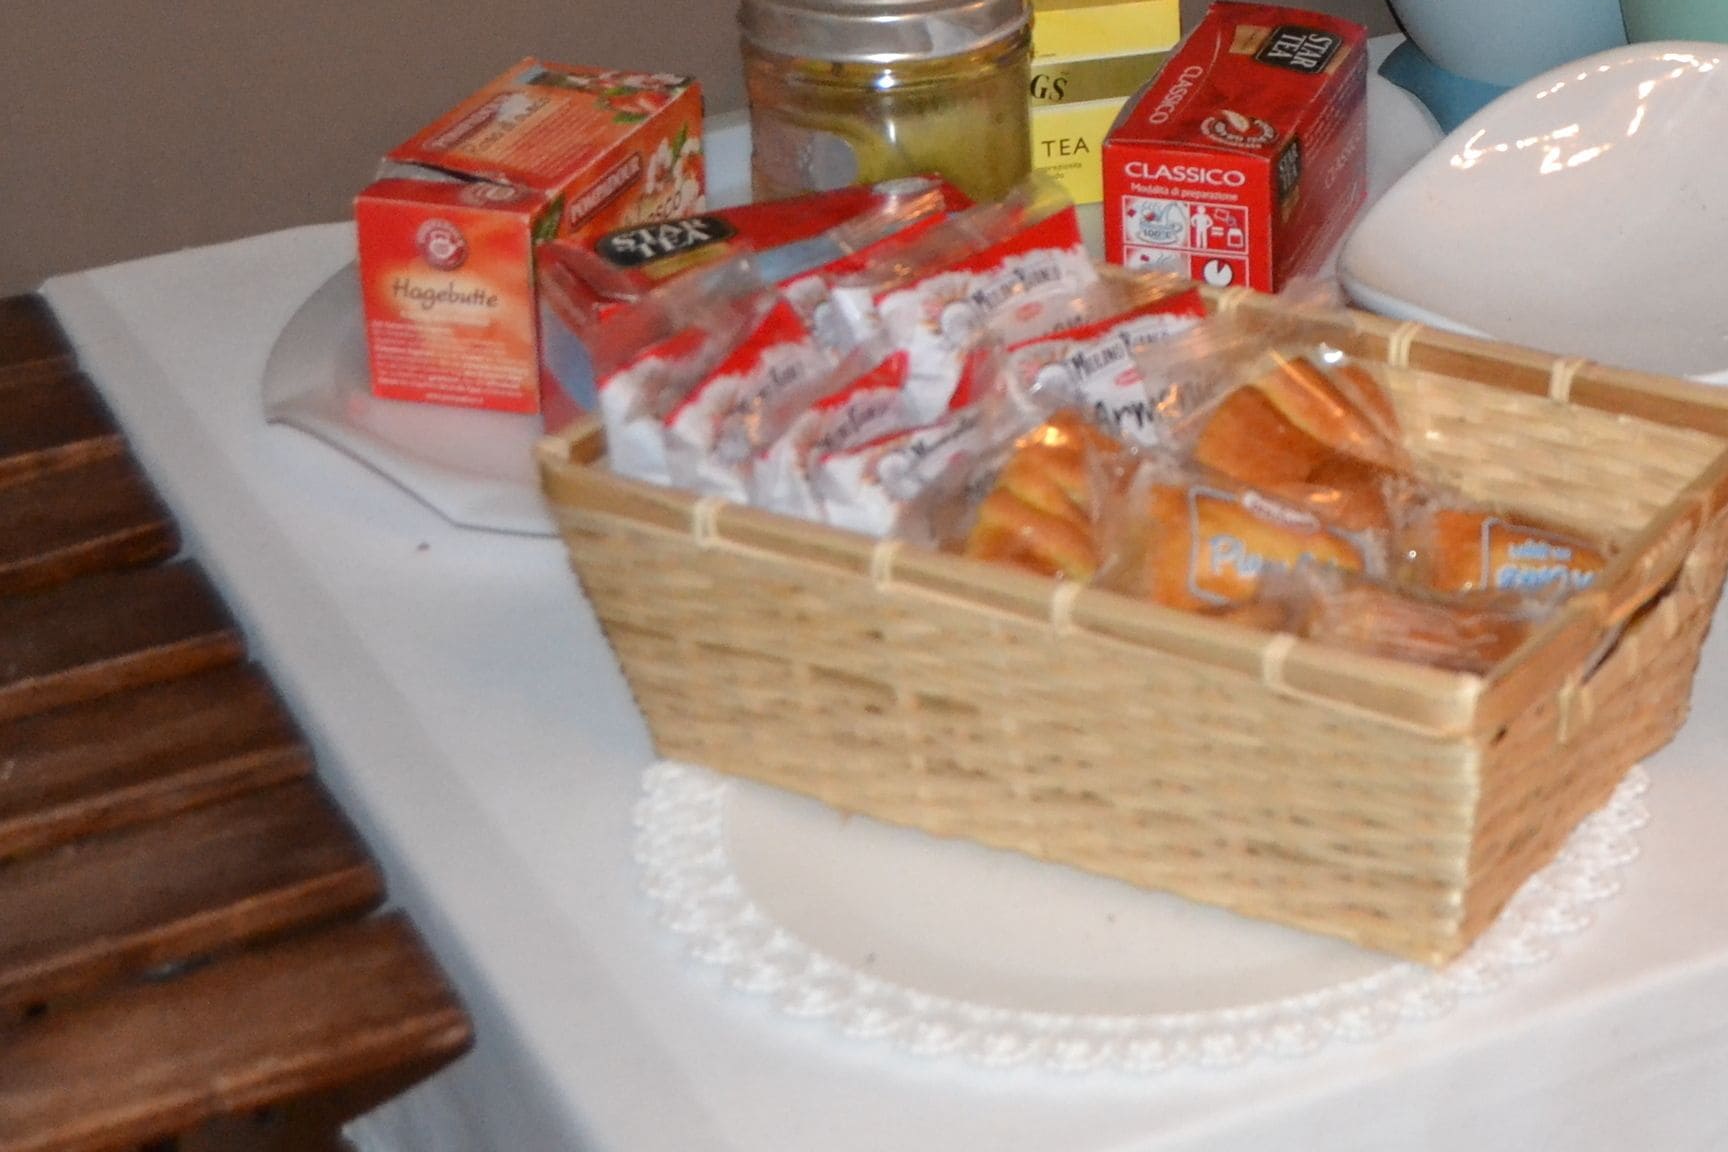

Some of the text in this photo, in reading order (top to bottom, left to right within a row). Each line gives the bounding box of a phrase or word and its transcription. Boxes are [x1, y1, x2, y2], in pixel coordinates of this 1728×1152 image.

[1267, 34, 1308, 60] TEA
[1291, 33, 1333, 71] STAR
[1149, 65, 1204, 125] CLASSICO
[1041, 137, 1090, 158] TEA
[1123, 161, 1246, 187] CLASSICO
[392, 278, 498, 310] Hagebutte
